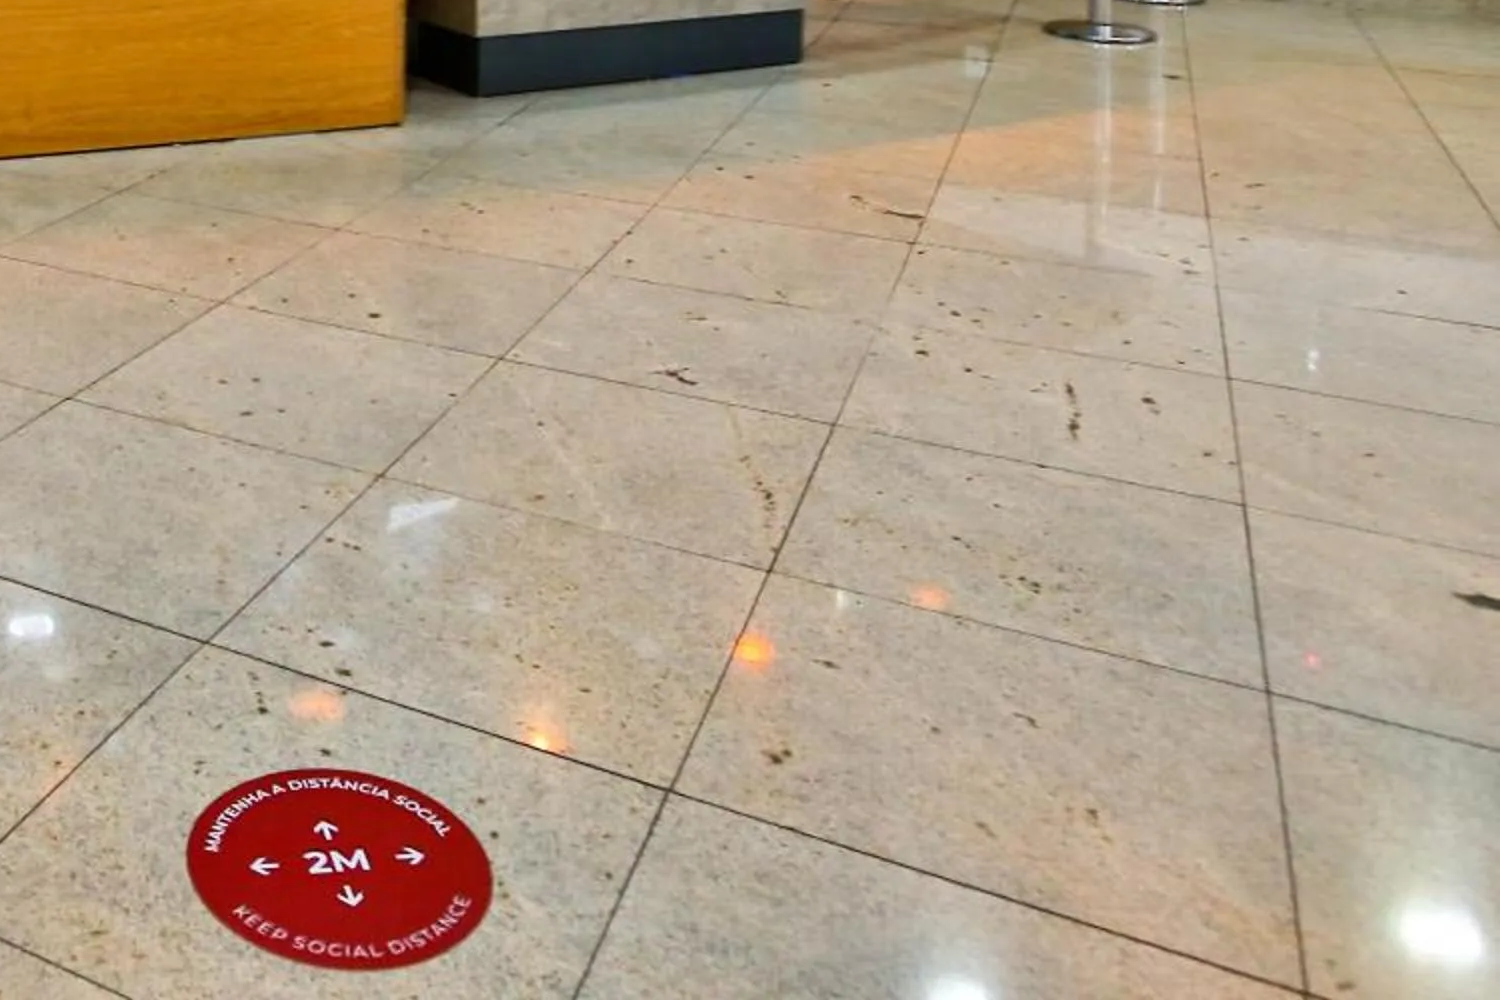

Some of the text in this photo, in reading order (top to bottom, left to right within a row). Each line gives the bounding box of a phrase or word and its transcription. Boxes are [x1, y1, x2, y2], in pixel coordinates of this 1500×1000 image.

[204, 776, 452, 852] MANTENHA A DISTÂNCIA SOCIAL
[302, 848, 371, 875] 2M
[231, 892, 473, 958] KEEP SOCIAL DISTANCE
